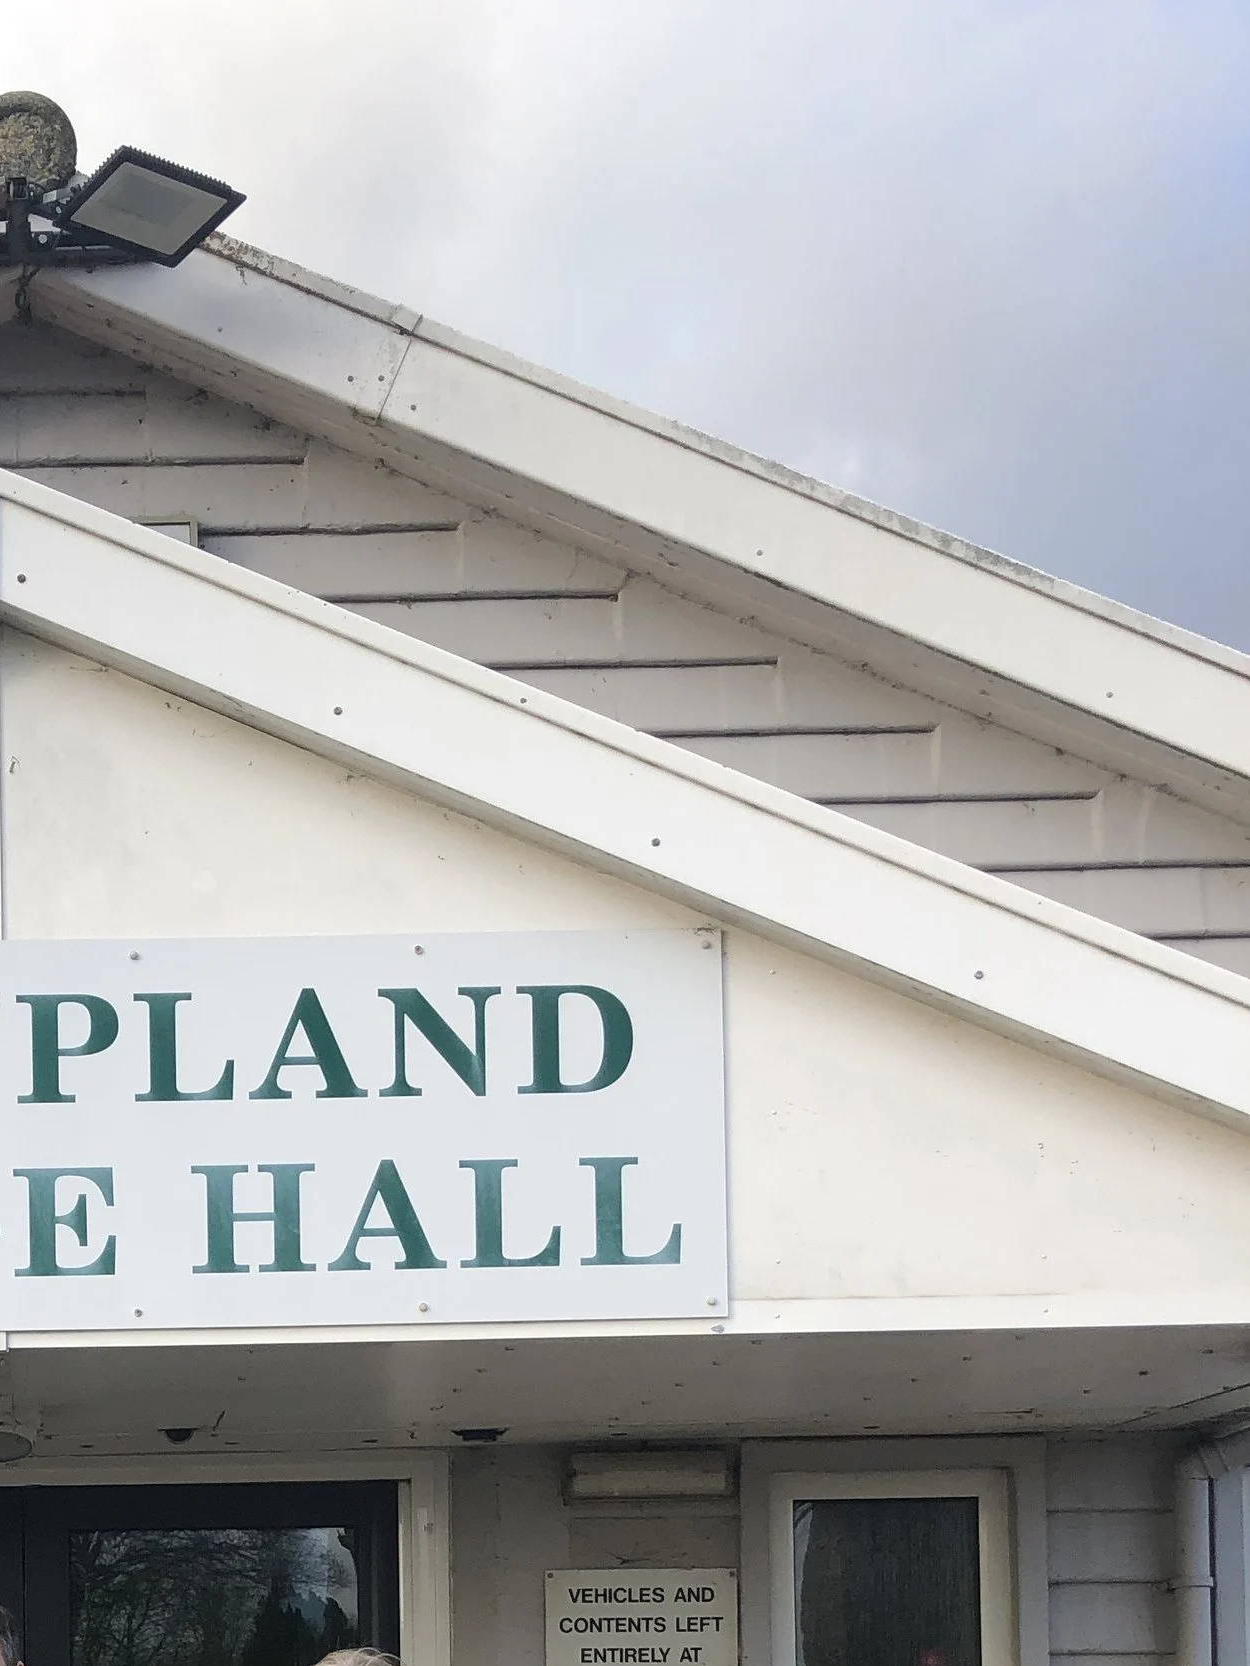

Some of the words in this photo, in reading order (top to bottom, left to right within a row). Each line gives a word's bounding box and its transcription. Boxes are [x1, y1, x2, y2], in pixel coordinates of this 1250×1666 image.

[191, 1157, 682, 1274] HALL
[567, 1587, 665, 1604] VEHICLES
[673, 1586, 716, 1603] AND
[559, 1617, 667, 1634] CONTENTS
[675, 1616, 724, 1633] LEFT
[580, 1648, 671, 1664] ENTIRELY
[679, 1647, 703, 1663] AT
